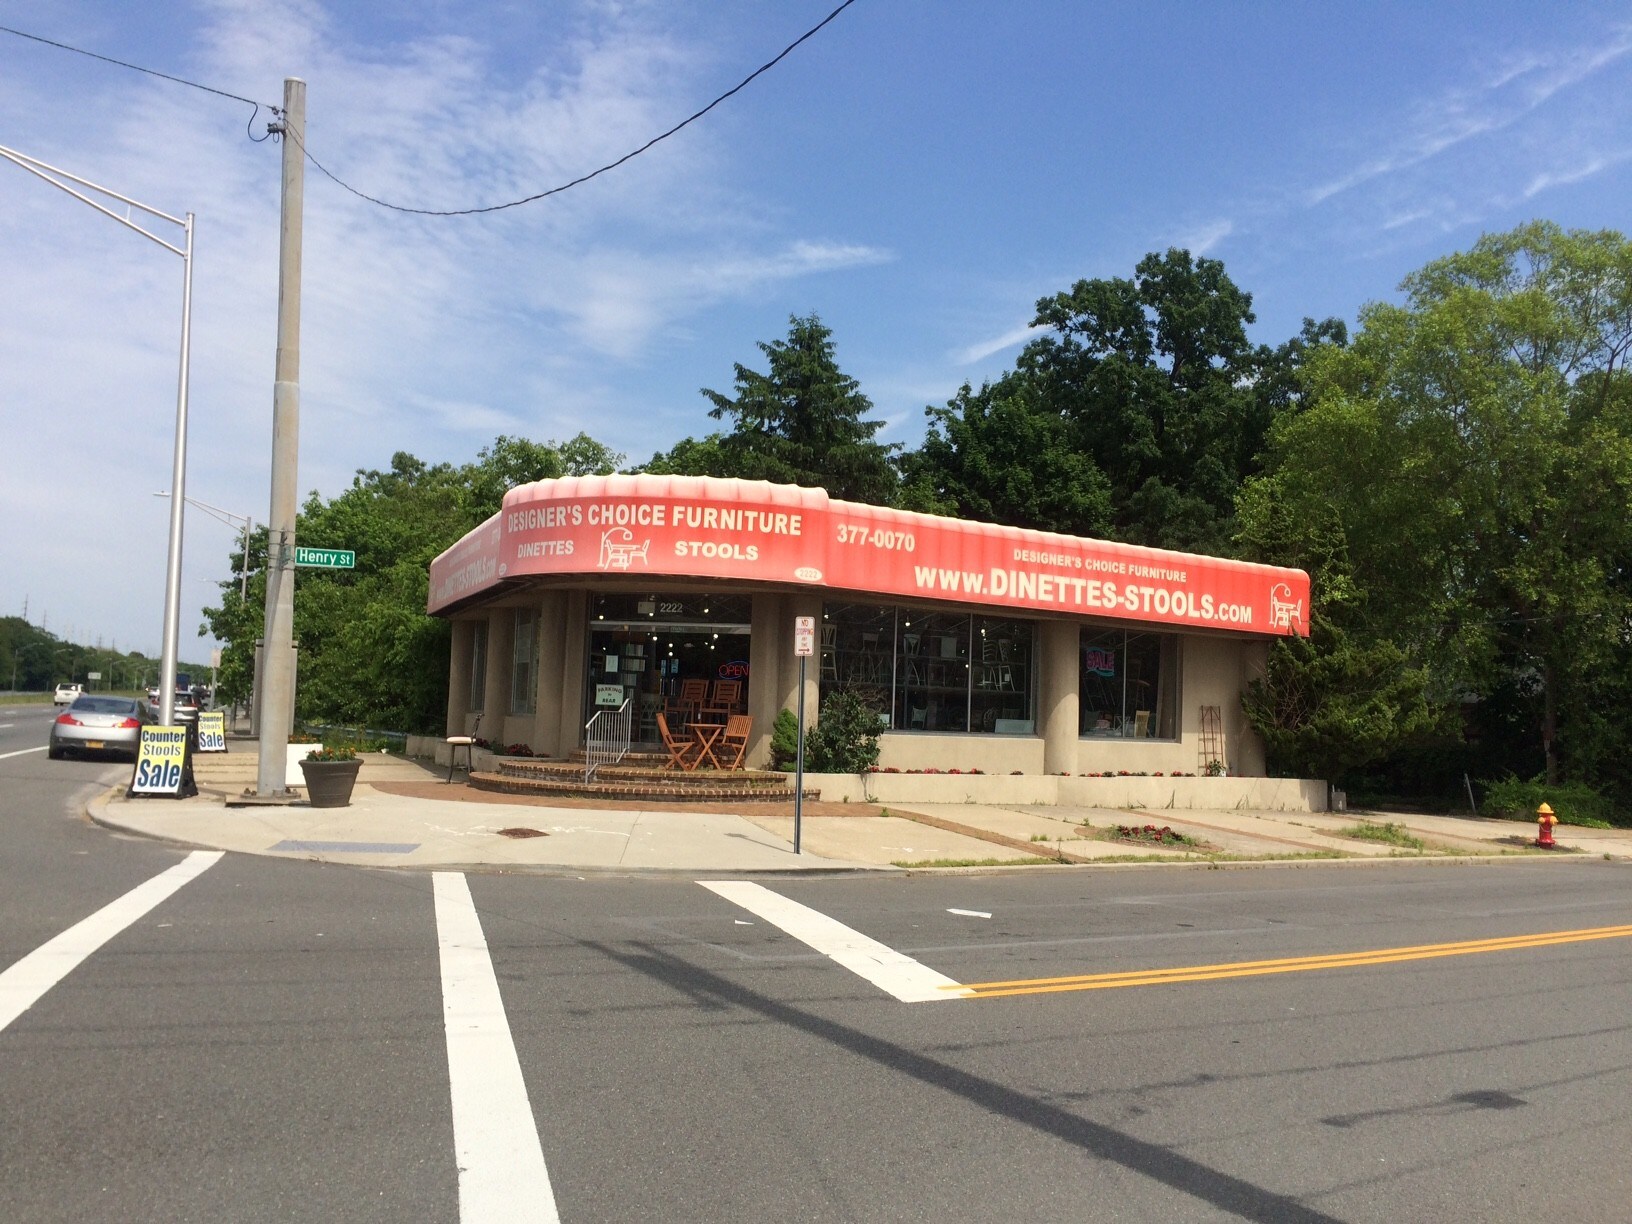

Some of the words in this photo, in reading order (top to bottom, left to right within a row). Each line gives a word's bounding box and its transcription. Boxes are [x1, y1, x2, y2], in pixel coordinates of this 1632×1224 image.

[508, 504, 583, 533] DESIGNER'S
[588, 503, 666, 527] CHOICE
[672, 505, 802, 536] FURNITURE
[837, 523, 916, 552] 377-0070
[299, 549, 337, 566] Henry
[340, 554, 350, 565] St
[517, 540, 574, 558] DINETTES
[674, 540, 759, 561] STOOLS
[799, 569, 818, 579] 2222
[1013, 548, 1082, 569] DESIGNER'S
[1085, 559, 1126, 575] CHOICE
[1128, 564, 1187, 583] FURNITURE
[660, 602, 683, 613] 2222
[1087, 651, 1114, 669] SALE
[719, 664, 749, 676] OPEN
[199, 714, 223, 722] Counter
[142, 730, 185, 742] Counter
[199, 731, 223, 748] Sale
[143, 744, 181, 756] Stools
[137, 758, 180, 788] Sale
